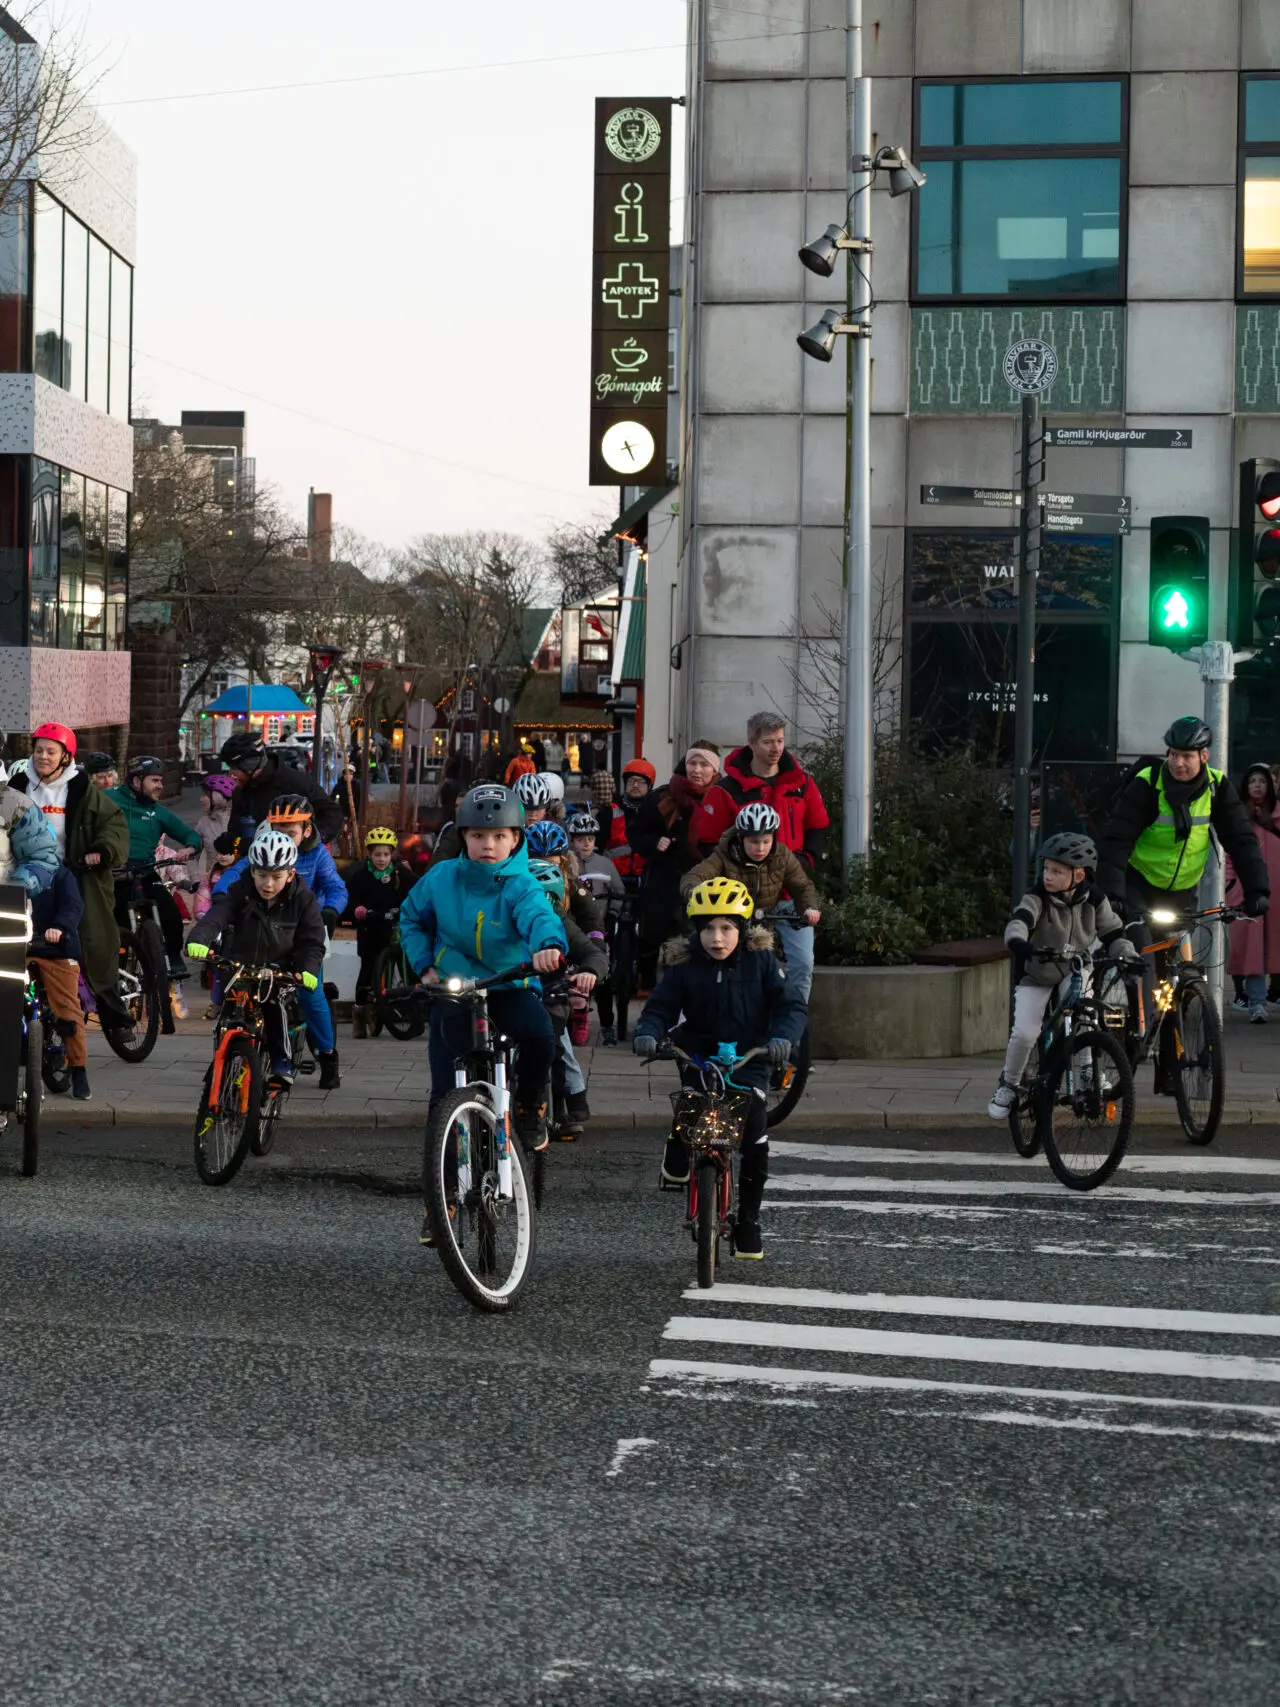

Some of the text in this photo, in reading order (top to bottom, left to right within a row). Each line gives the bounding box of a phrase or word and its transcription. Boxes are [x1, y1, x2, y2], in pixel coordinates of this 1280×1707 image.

[609, 286, 652, 295] APOTEK
[1057, 429, 1147, 441] Gamli kirkjugarður
